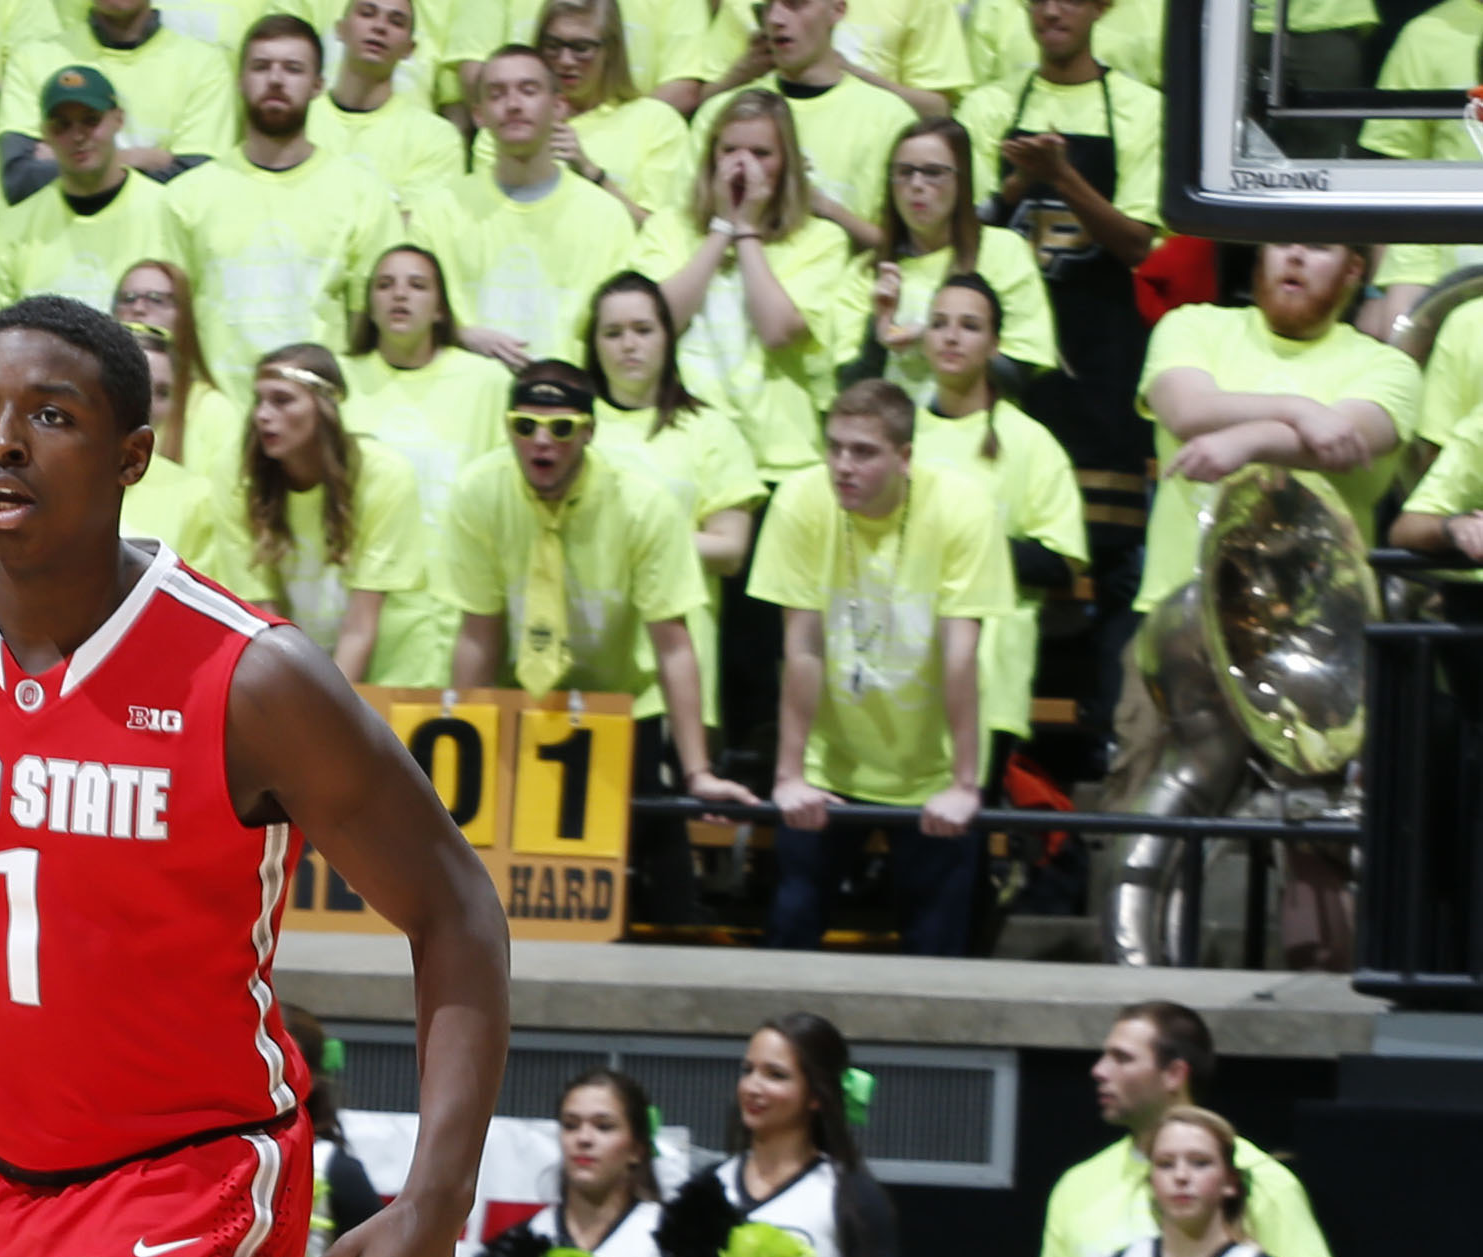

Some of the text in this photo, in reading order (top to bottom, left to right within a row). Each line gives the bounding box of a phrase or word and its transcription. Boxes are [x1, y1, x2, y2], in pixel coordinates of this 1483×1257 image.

[1230, 169, 1330, 192] SPALDING
[10, 754, 171, 840] STATE
[509, 865, 615, 922] HARD
